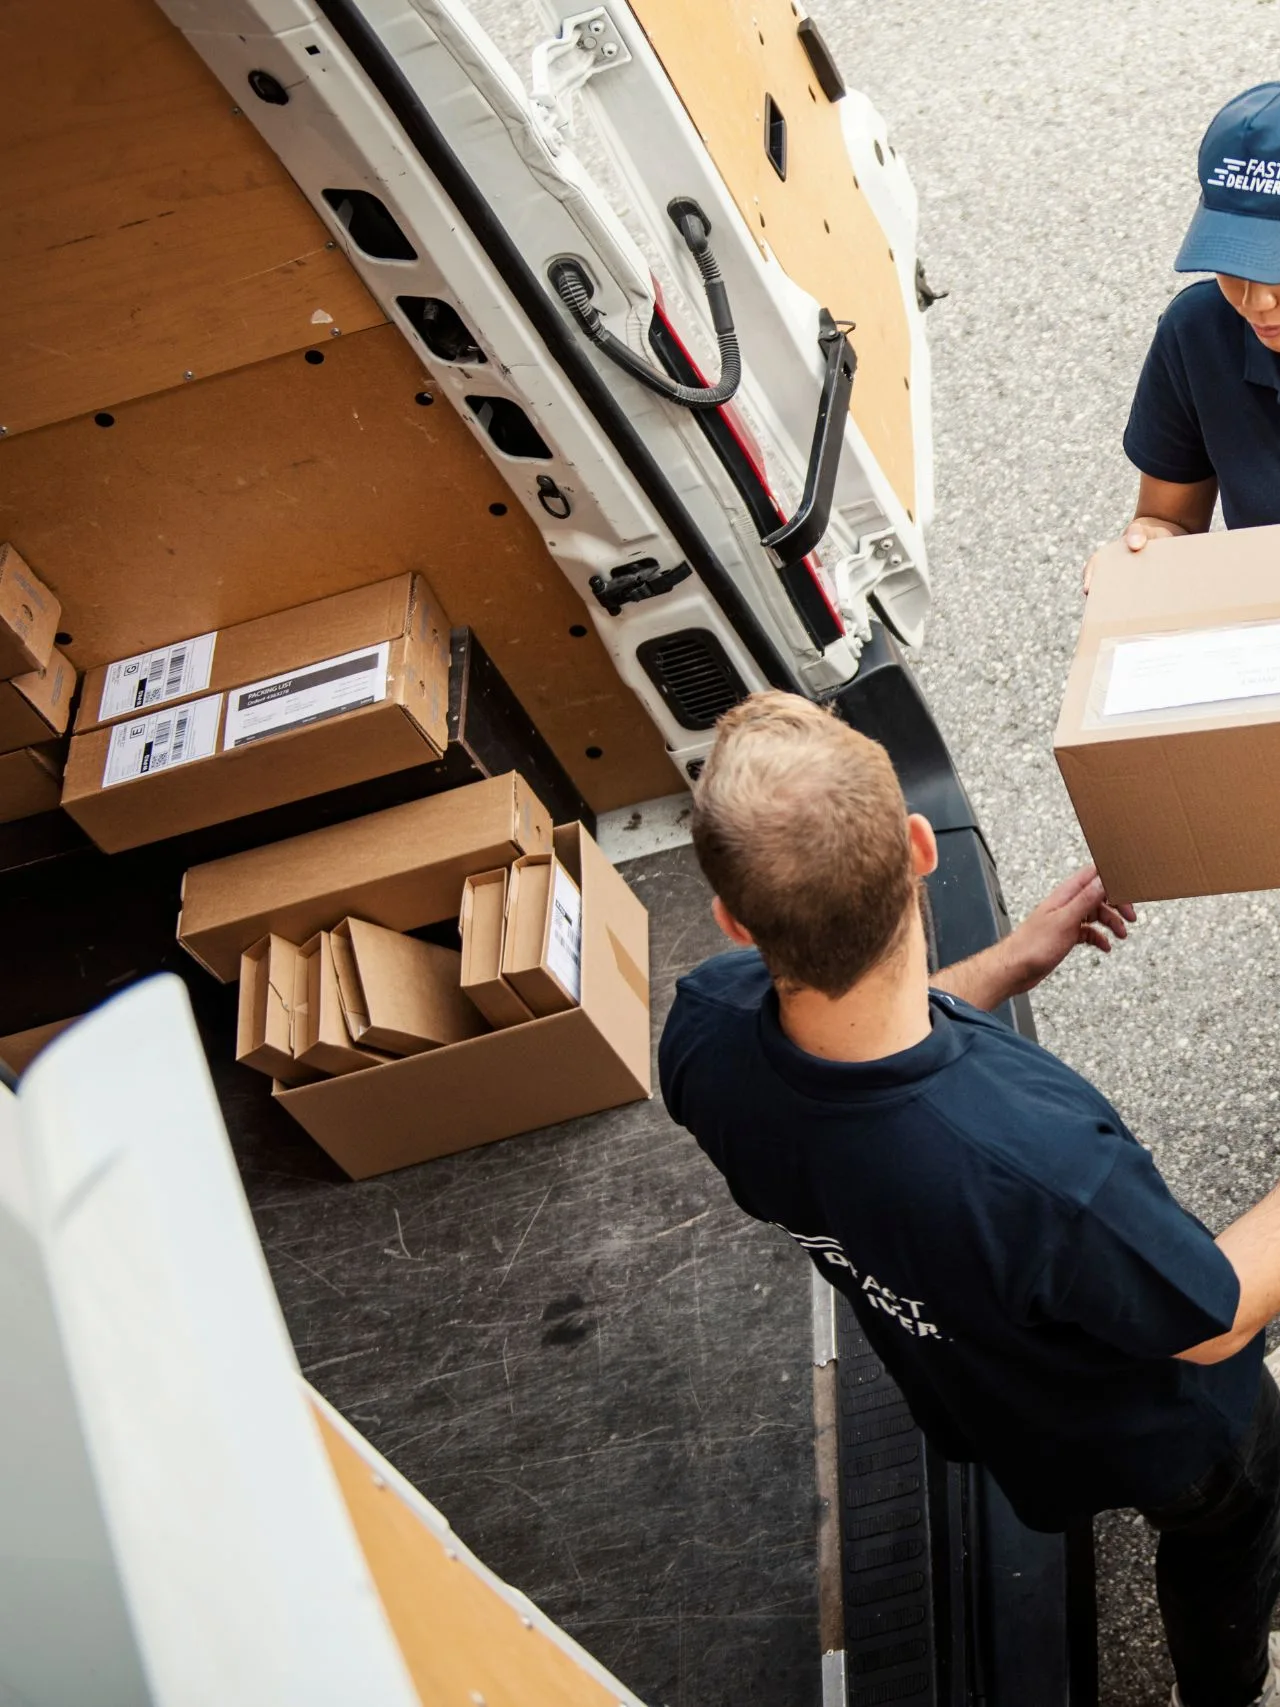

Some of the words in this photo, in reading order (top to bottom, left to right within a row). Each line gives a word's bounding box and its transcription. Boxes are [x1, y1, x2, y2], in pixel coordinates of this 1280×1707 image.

[247, 686, 278, 700] PACKING
[278, 681, 293, 690] LIST
[132, 726, 143, 736] E
